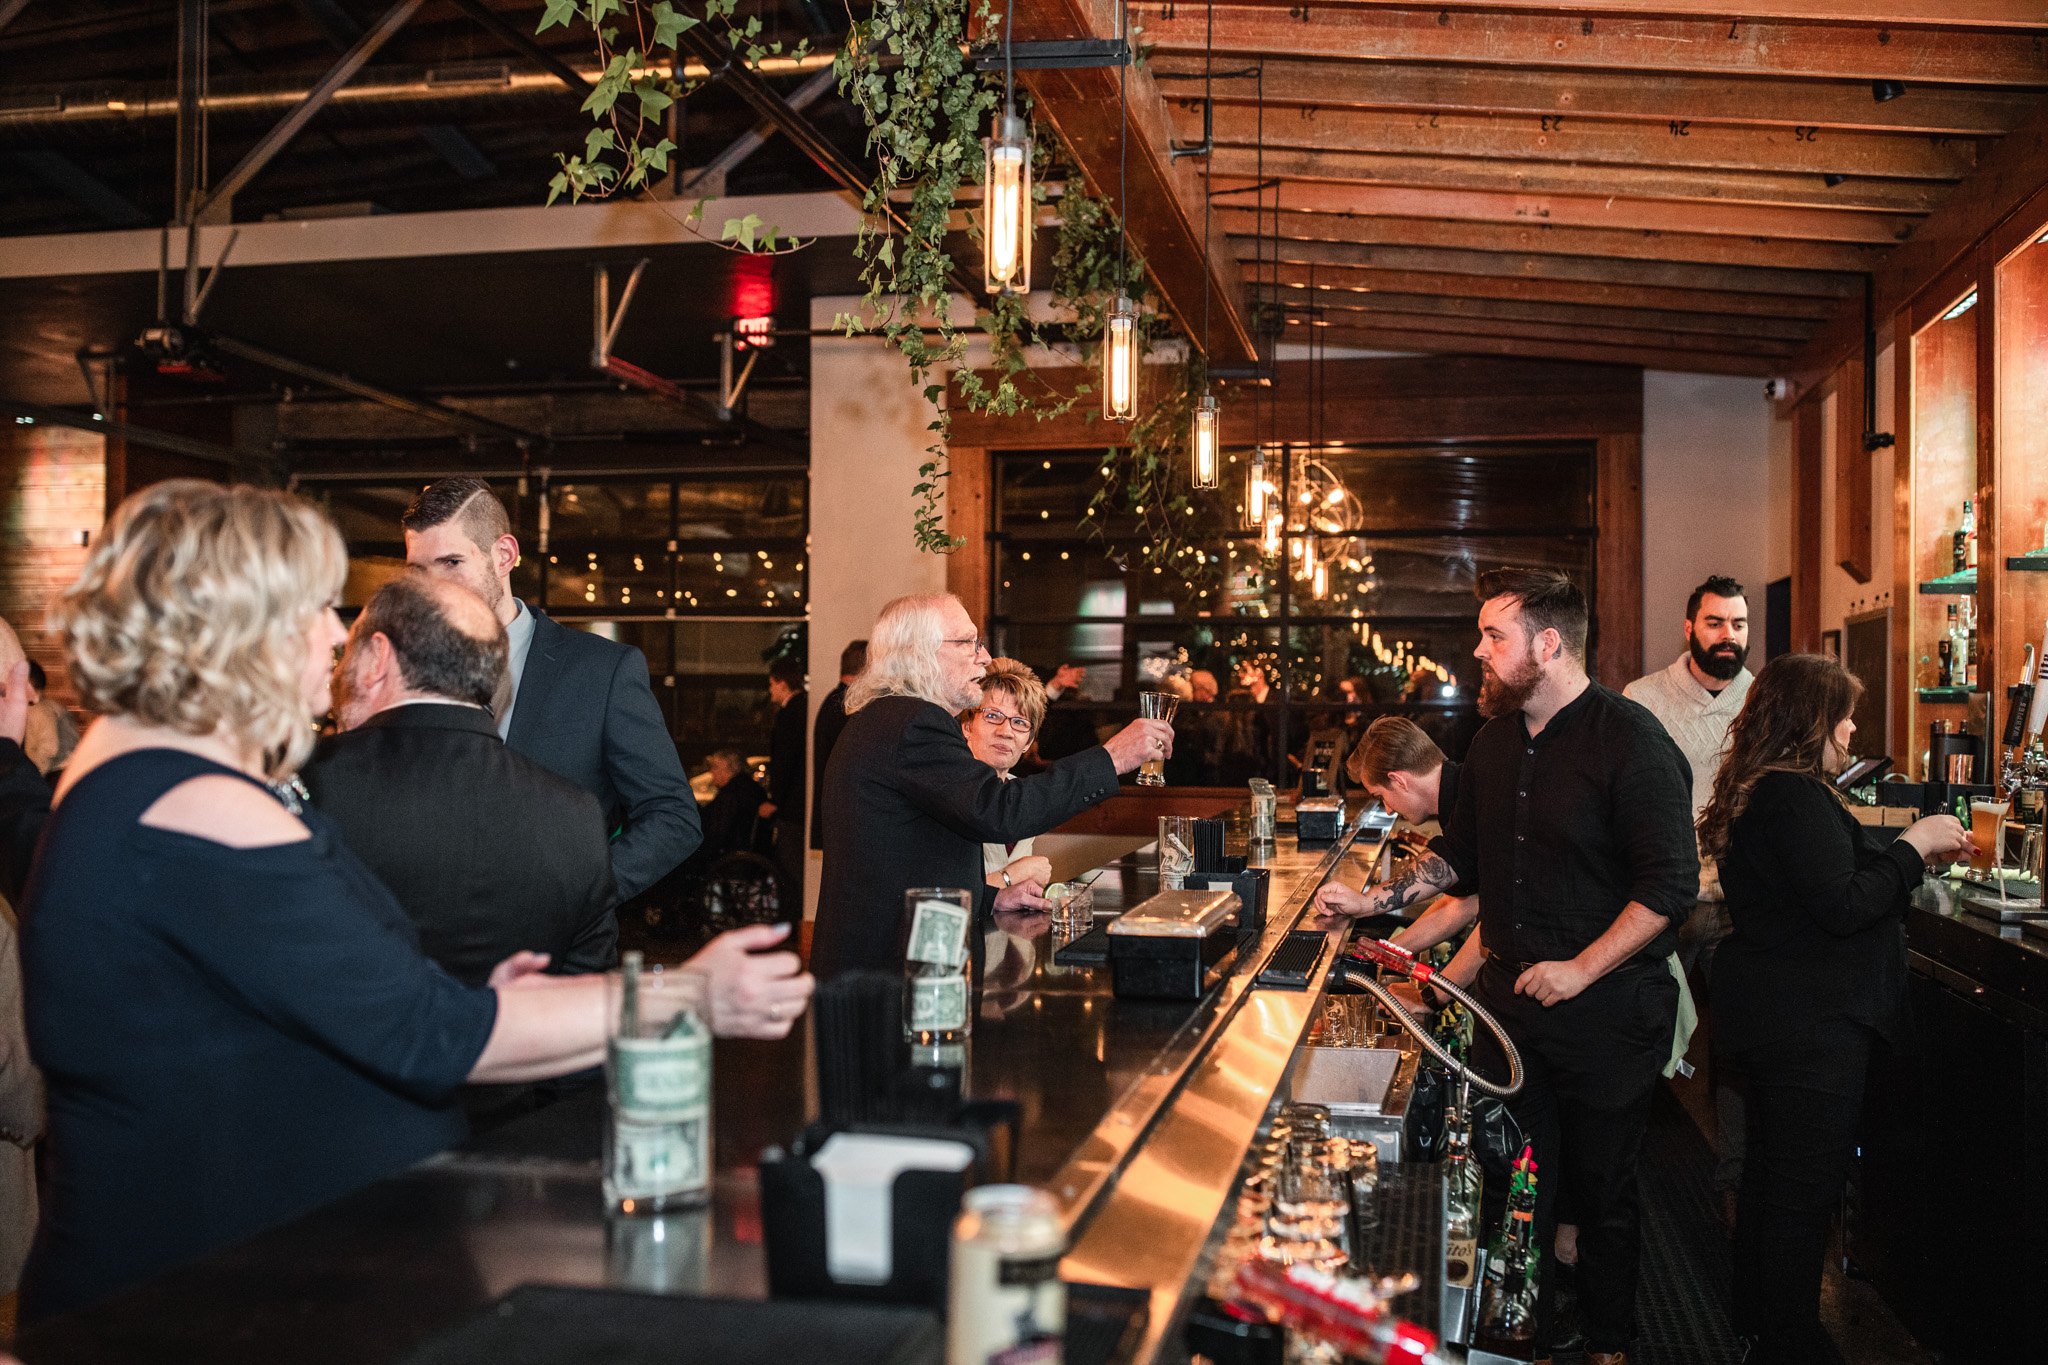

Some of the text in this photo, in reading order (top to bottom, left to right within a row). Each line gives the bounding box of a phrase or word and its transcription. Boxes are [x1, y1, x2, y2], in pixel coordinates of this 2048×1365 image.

[1541, 114, 1564, 131] 23
[1669, 120, 1692, 136] 24
[1795, 126, 1819, 142] 25
[1446, 1242, 1473, 1257] ito's
